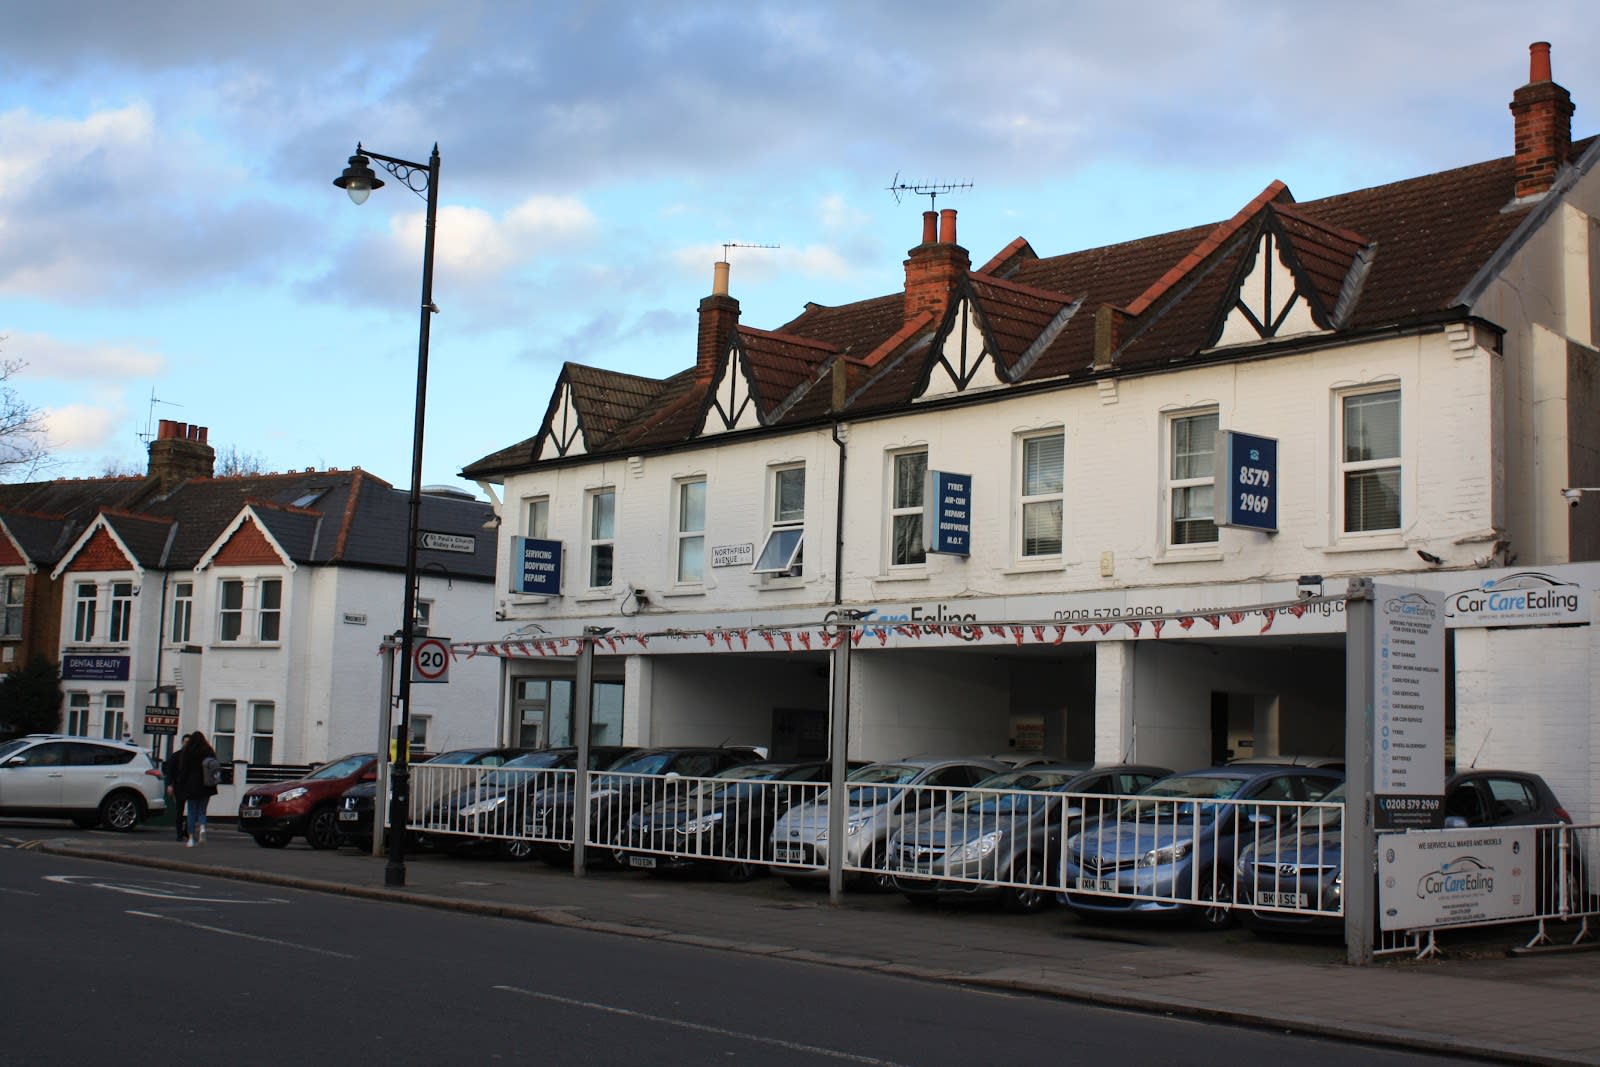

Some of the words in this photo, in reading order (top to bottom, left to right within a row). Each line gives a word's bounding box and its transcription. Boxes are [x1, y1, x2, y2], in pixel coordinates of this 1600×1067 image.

[1240, 466, 1270, 487] 8579
[948, 482, 963, 491] TYRES
[1240, 492, 1268, 513] 2969
[944, 510, 965, 518] REPAIRS
[940, 522, 968, 532] BODYWORK
[525, 550, 552, 559] SERVICING
[714, 546, 750, 556] NORTHFIELD
[715, 556, 737, 564] AVENUE
[525, 562, 555, 572] BODYWORK
[525, 573, 546, 582] REPAIRS
[1527, 590, 1578, 612] Ealing
[70, 659, 94, 667] DENTAL
[96, 659, 120, 668] BEAUTY
[421, 652, 443, 668] 20
[1386, 799, 1406, 809] 0208
[1407, 800, 1420, 809] 579
[1421, 800, 1439, 810] 2969
[1466, 873, 1494, 893] Ealing
